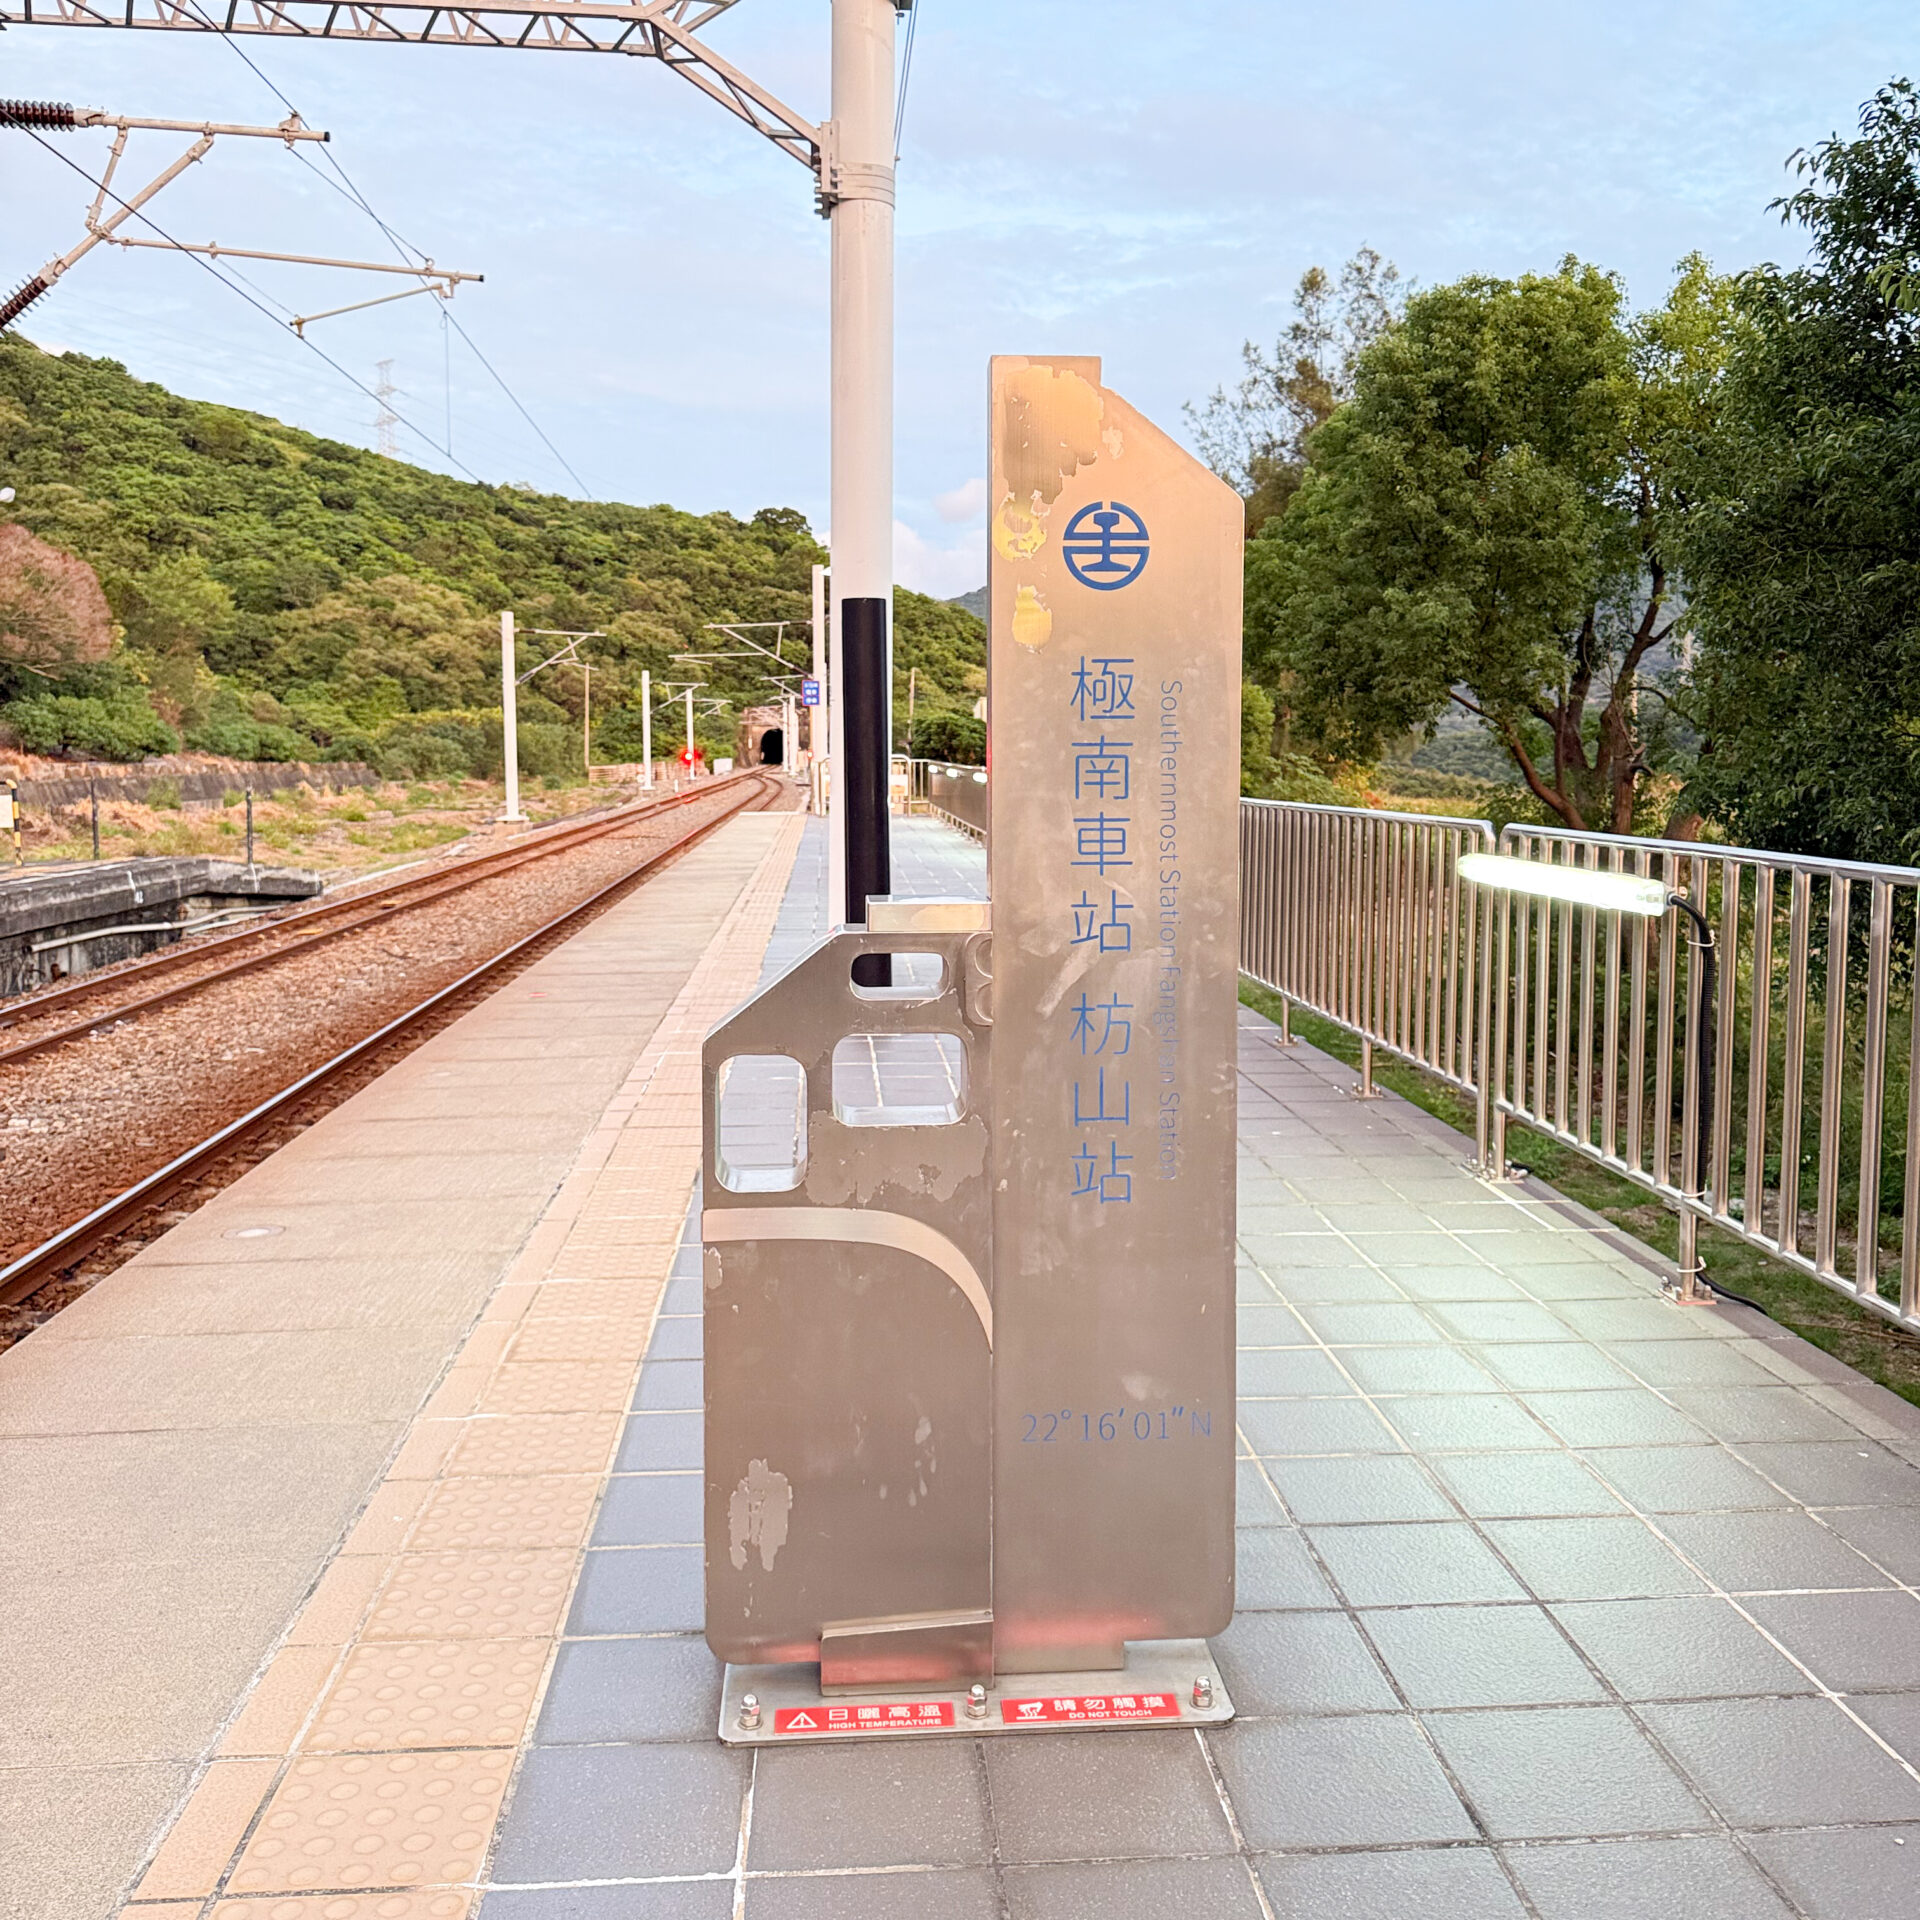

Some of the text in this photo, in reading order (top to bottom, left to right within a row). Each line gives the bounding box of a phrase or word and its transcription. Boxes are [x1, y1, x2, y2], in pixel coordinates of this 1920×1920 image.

[1070, 655, 1136, 1204] 極南車站 枋山站
[1152, 680, 1183, 1180] Southernmost Station Fangshan Station
[828, 1718, 942, 1730] HIGH TEMPERATURE
[1068, 1709, 1152, 1719] DO NOT TOUCH
